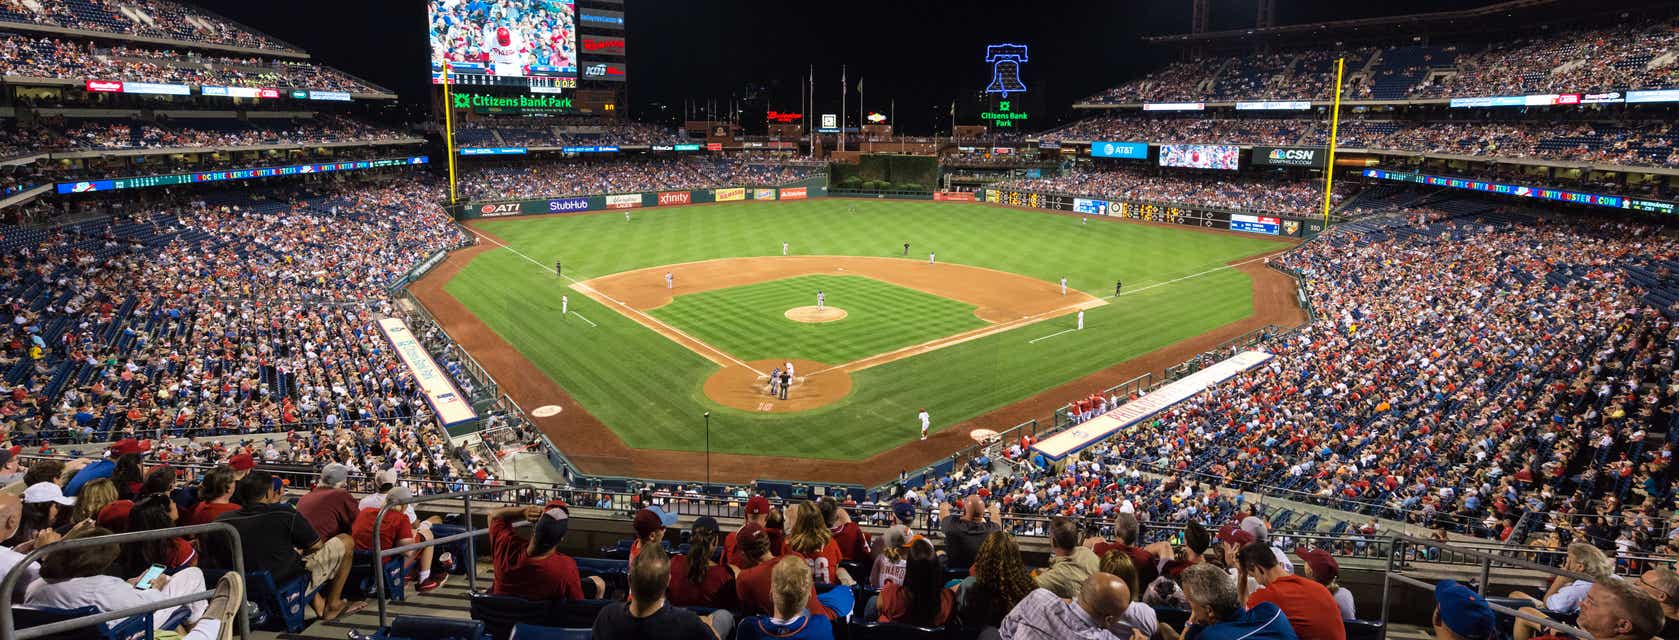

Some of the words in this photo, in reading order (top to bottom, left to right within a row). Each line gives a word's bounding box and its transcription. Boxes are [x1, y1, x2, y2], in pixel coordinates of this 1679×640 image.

[473, 95, 518, 107] Citizens
[520, 96, 547, 107] Bank
[549, 97, 571, 108] Park
[1115, 146, 1134, 154] AT&T
[1286, 150, 1314, 160] CSN
[661, 193, 688, 204] xfinity
[495, 203, 520, 212] ATI
[549, 201, 588, 211] StubHub
